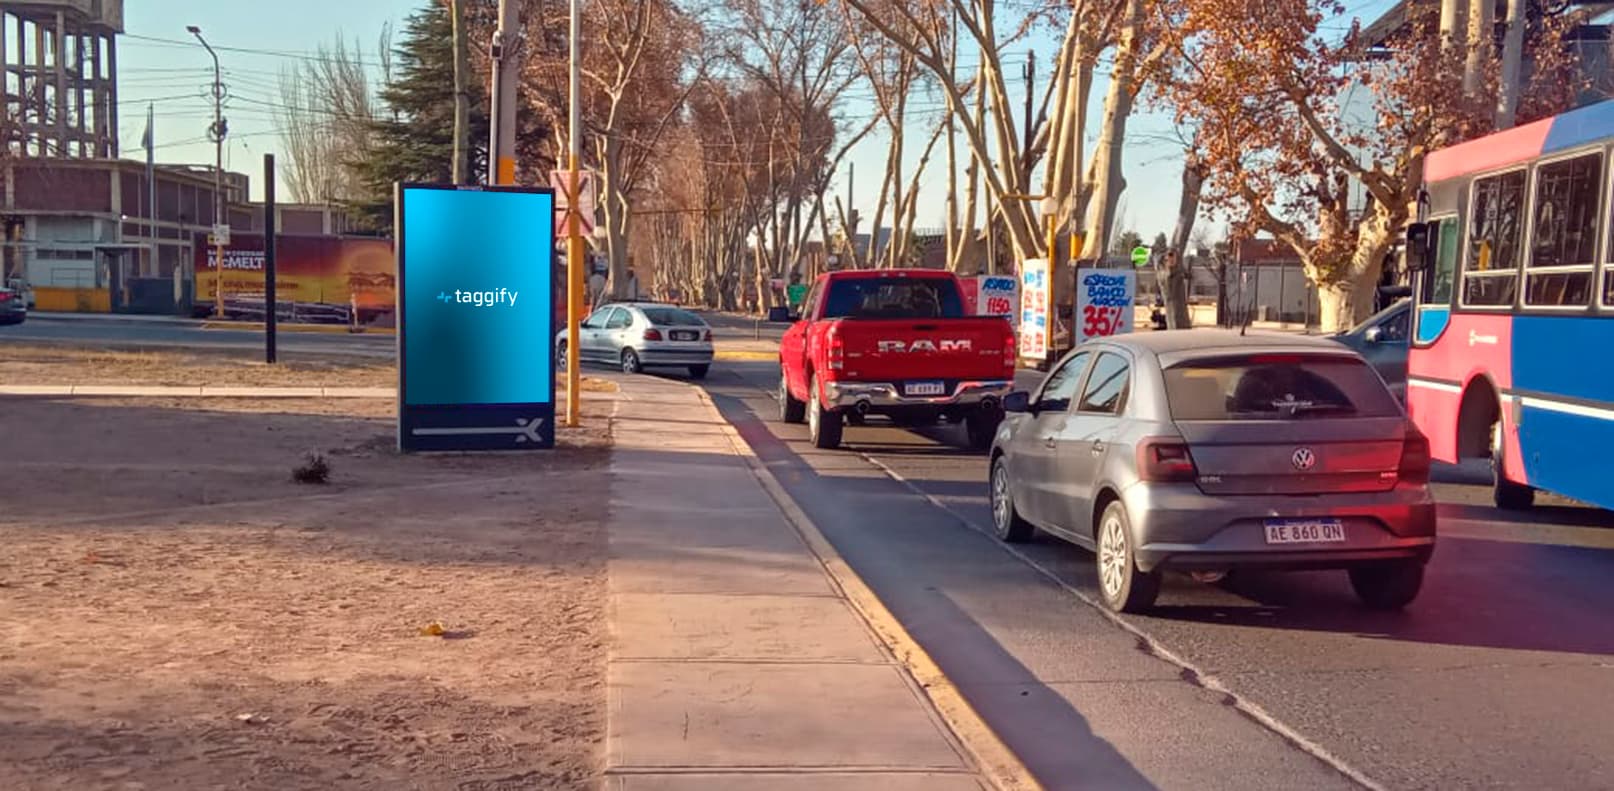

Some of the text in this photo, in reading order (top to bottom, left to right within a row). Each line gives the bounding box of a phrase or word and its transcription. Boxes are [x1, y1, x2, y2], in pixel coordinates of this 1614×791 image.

[207, 256, 265, 269] McMELT
[454, 287, 518, 307] taggify
[1088, 286, 1126, 297] BANCO
[1083, 305, 1124, 337] 35%
[877, 339, 972, 353] RAM
[1271, 525, 1342, 541] AE 860 QN
